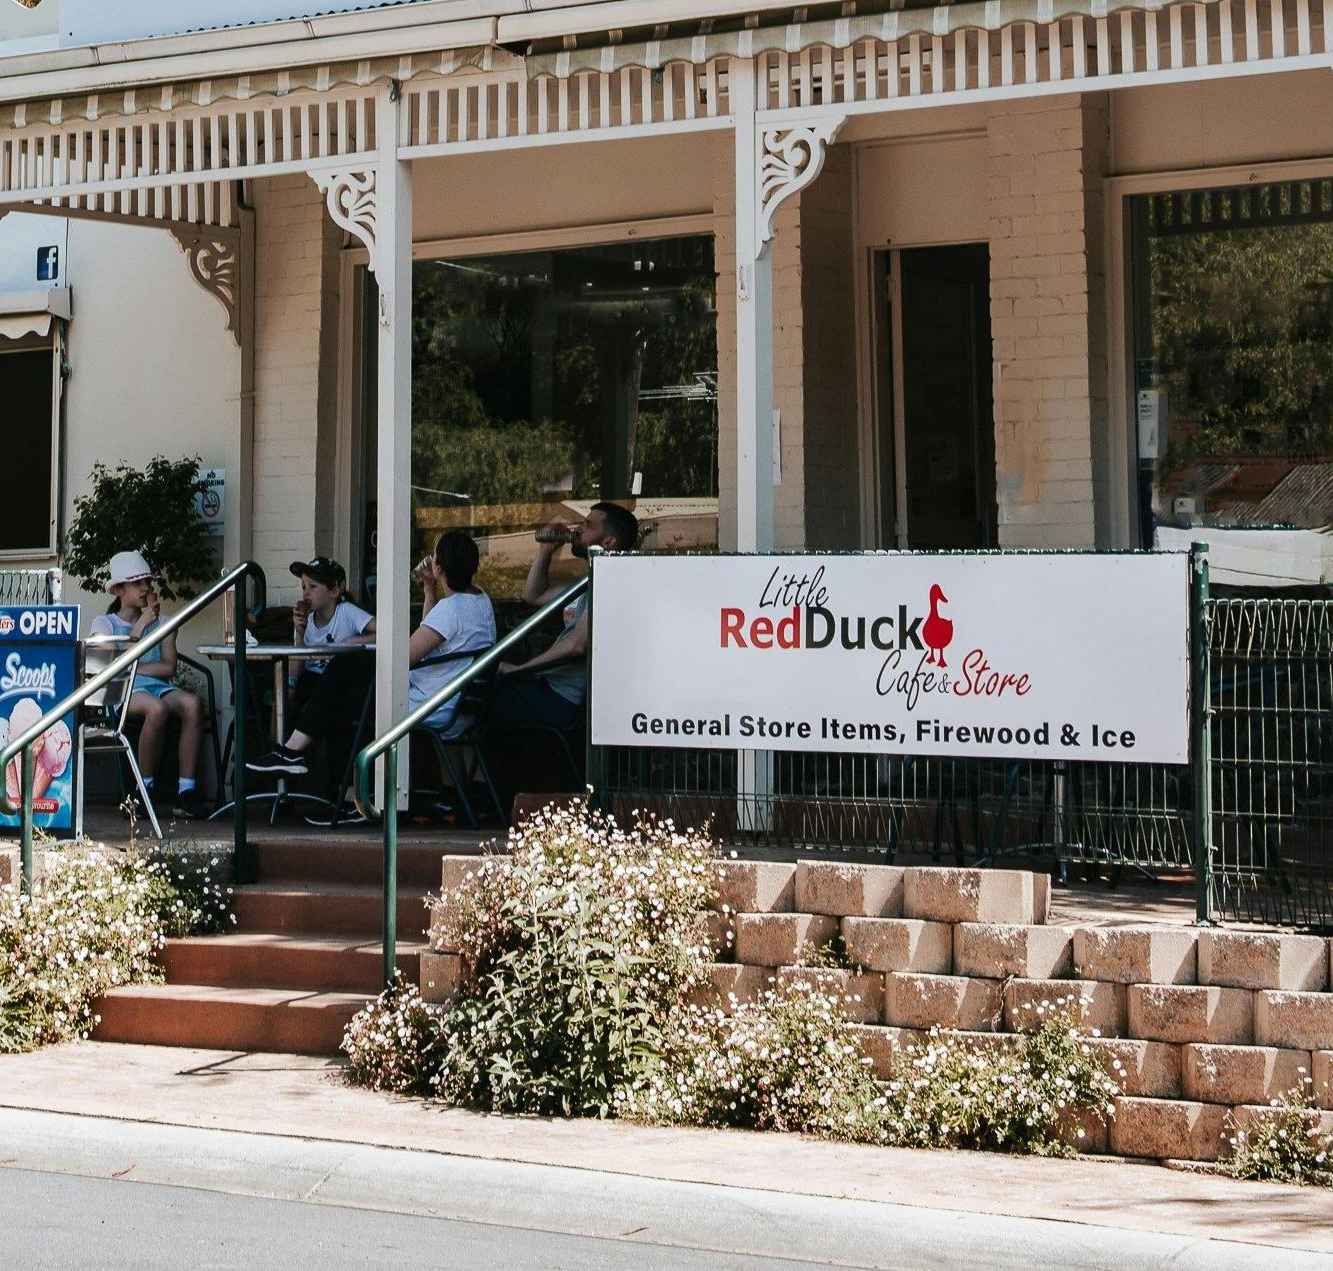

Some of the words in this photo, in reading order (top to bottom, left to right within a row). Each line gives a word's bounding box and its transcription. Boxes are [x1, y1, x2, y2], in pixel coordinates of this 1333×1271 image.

[759, 565, 829, 608] Little
[19, 610, 73, 635] OPEN
[720, 604, 925, 650] RedDuck
[0, 652, 57, 699] Scoops
[875, 649, 939, 712] Cafe
[952, 649, 1032, 697] Store
[631, 712, 731, 736] General
[739, 715, 811, 739] Store
[821, 717, 906, 744] Items,
[915, 719, 1050, 745] Firewood
[1059, 723, 1082, 747] &
[1092, 724, 1136, 748] Ice
